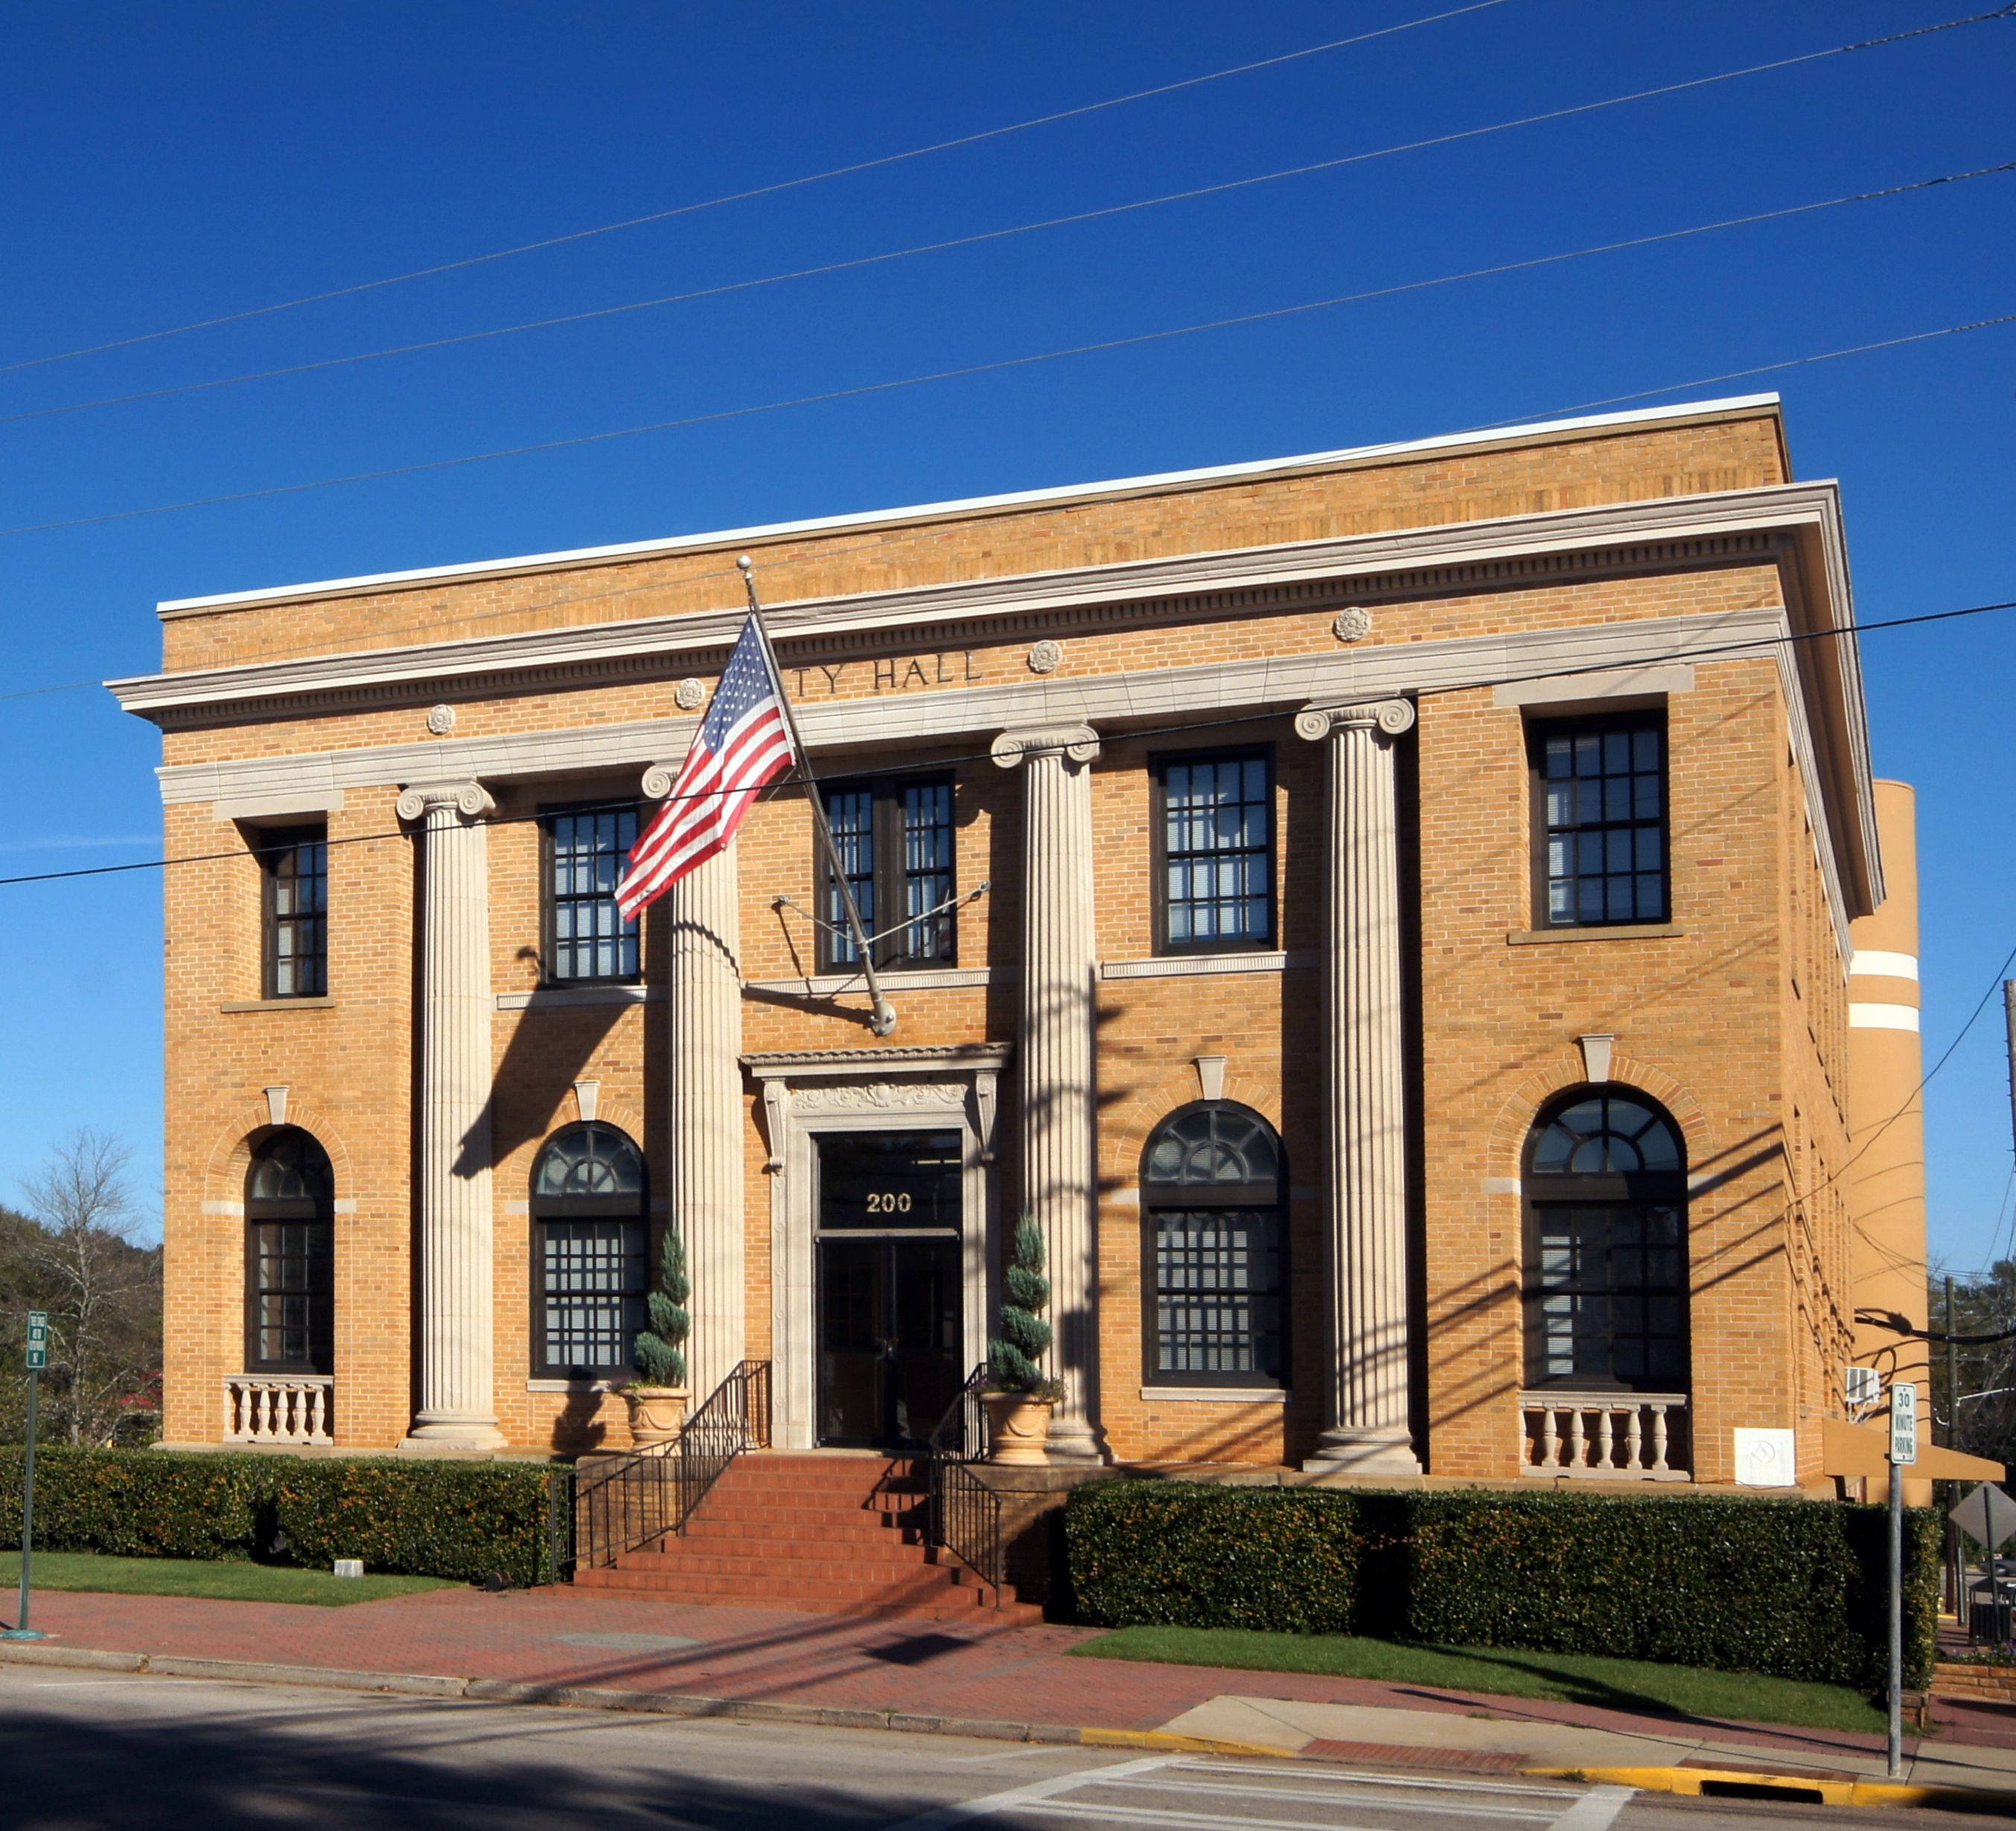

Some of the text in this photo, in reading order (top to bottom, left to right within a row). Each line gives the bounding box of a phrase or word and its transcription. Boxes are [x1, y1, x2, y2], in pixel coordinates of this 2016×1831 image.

[793, 650, 983, 697] TY HALL
[866, 1192, 912, 1213] 200
[1898, 1392, 1910, 1407] 30
[1895, 1414, 1913, 1431] MINUTE
[1895, 1436, 1913, 1454] PARKING
